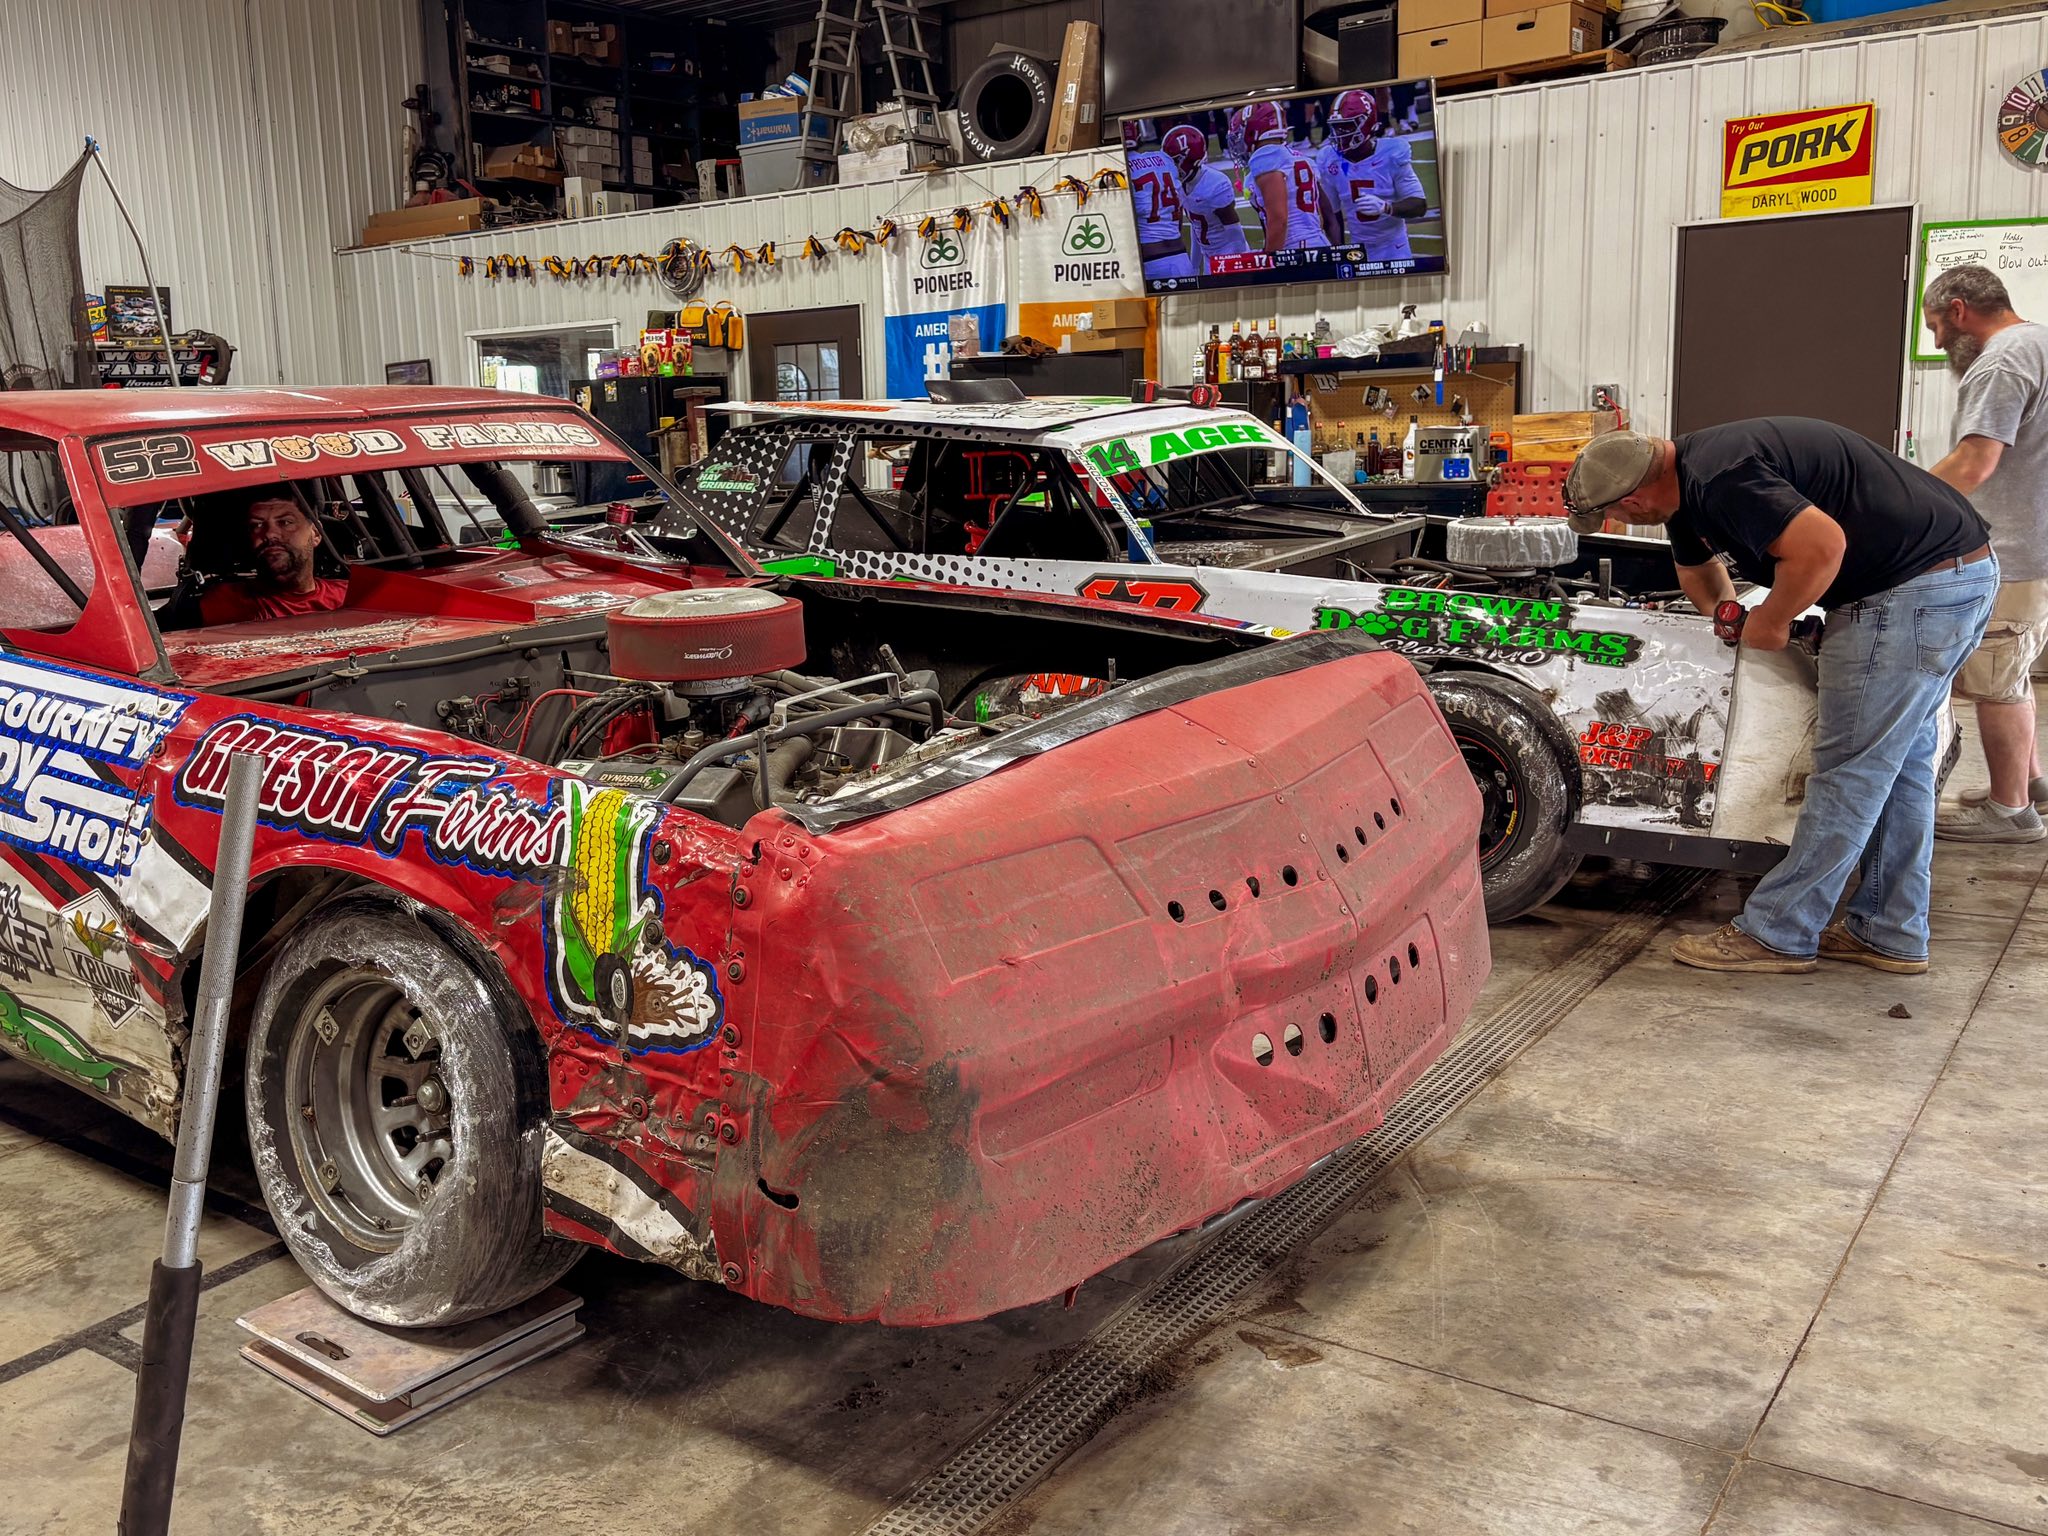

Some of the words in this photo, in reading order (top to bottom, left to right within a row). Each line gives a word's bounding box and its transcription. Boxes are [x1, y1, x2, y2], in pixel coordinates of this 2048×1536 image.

[1010, 53, 1046, 104] Hoosier
[757, 123, 792, 136] Walmart
[960, 111, 996, 159] Hoosier
[1731, 124, 1745, 135] Try
[1747, 121, 1765, 131] Our
[1739, 118, 1860, 176] PORK
[1132, 172, 1182, 223] 74
[1294, 160, 1316, 214] 8
[1752, 193, 1793, 209] DARYL
[1800, 188, 1837, 204] WOOD
[1254, 254, 1267, 267] 17
[1304, 250, 1318, 262] 17
[914, 271, 973, 295] PIONEER
[1054, 261, 1120, 282] PIONEER
[91, 363, 201, 378] FARMS
[414, 422, 600, 452] FARMS
[1151, 424, 1272, 464] AGEE
[1419, 438, 1474, 449] CENTRAL
[97, 433, 202, 485] 52
[1087, 438, 1140, 478] 14
[698, 481, 755, 491] GRINDING
[699, 473, 721, 481] HAY
[1384, 589, 1565, 622] BROWN
[1445, 618, 1629, 657] FARMS
[1585, 653, 1625, 666] LLC
[599, 773, 652, 783] DYNOSOAR
[10, 774, 145, 868] SHOP
[381, 761, 567, 866] Farms
[98, 993, 127, 1011] FARMS
